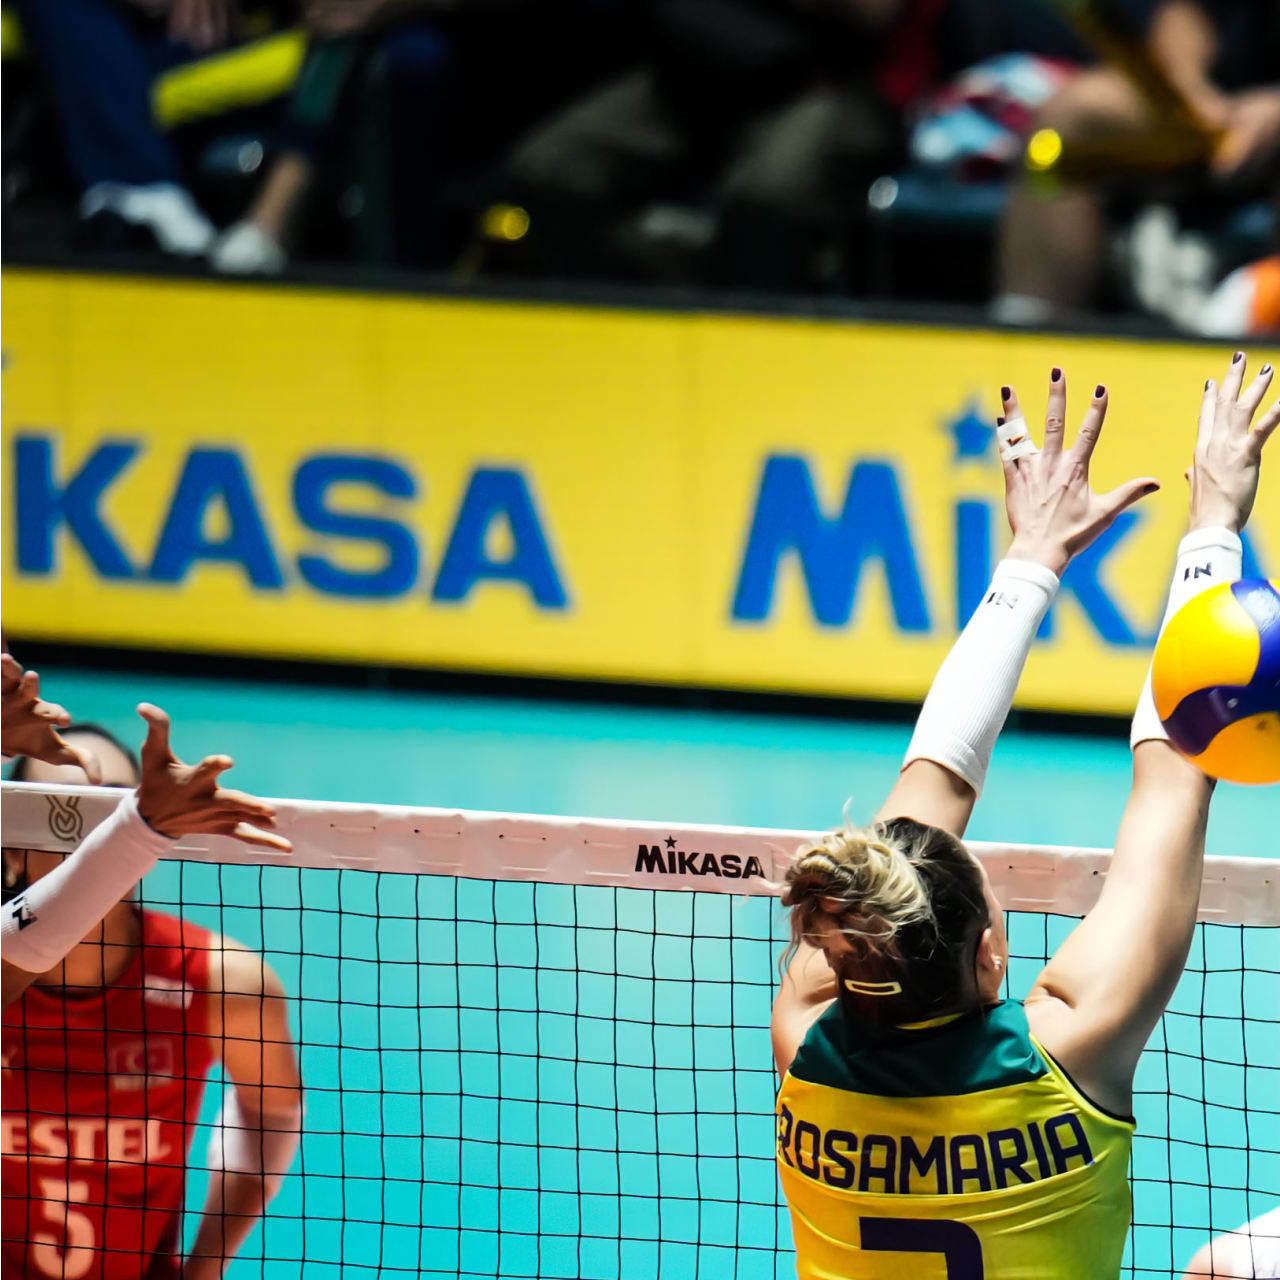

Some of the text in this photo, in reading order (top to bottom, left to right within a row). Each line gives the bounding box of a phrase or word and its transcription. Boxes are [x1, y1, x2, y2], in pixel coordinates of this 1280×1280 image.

[635, 835, 767, 879] MIKASA
[777, 1103, 1096, 1195] ROSAMARIA
[32, 1178, 95, 1280] 5
